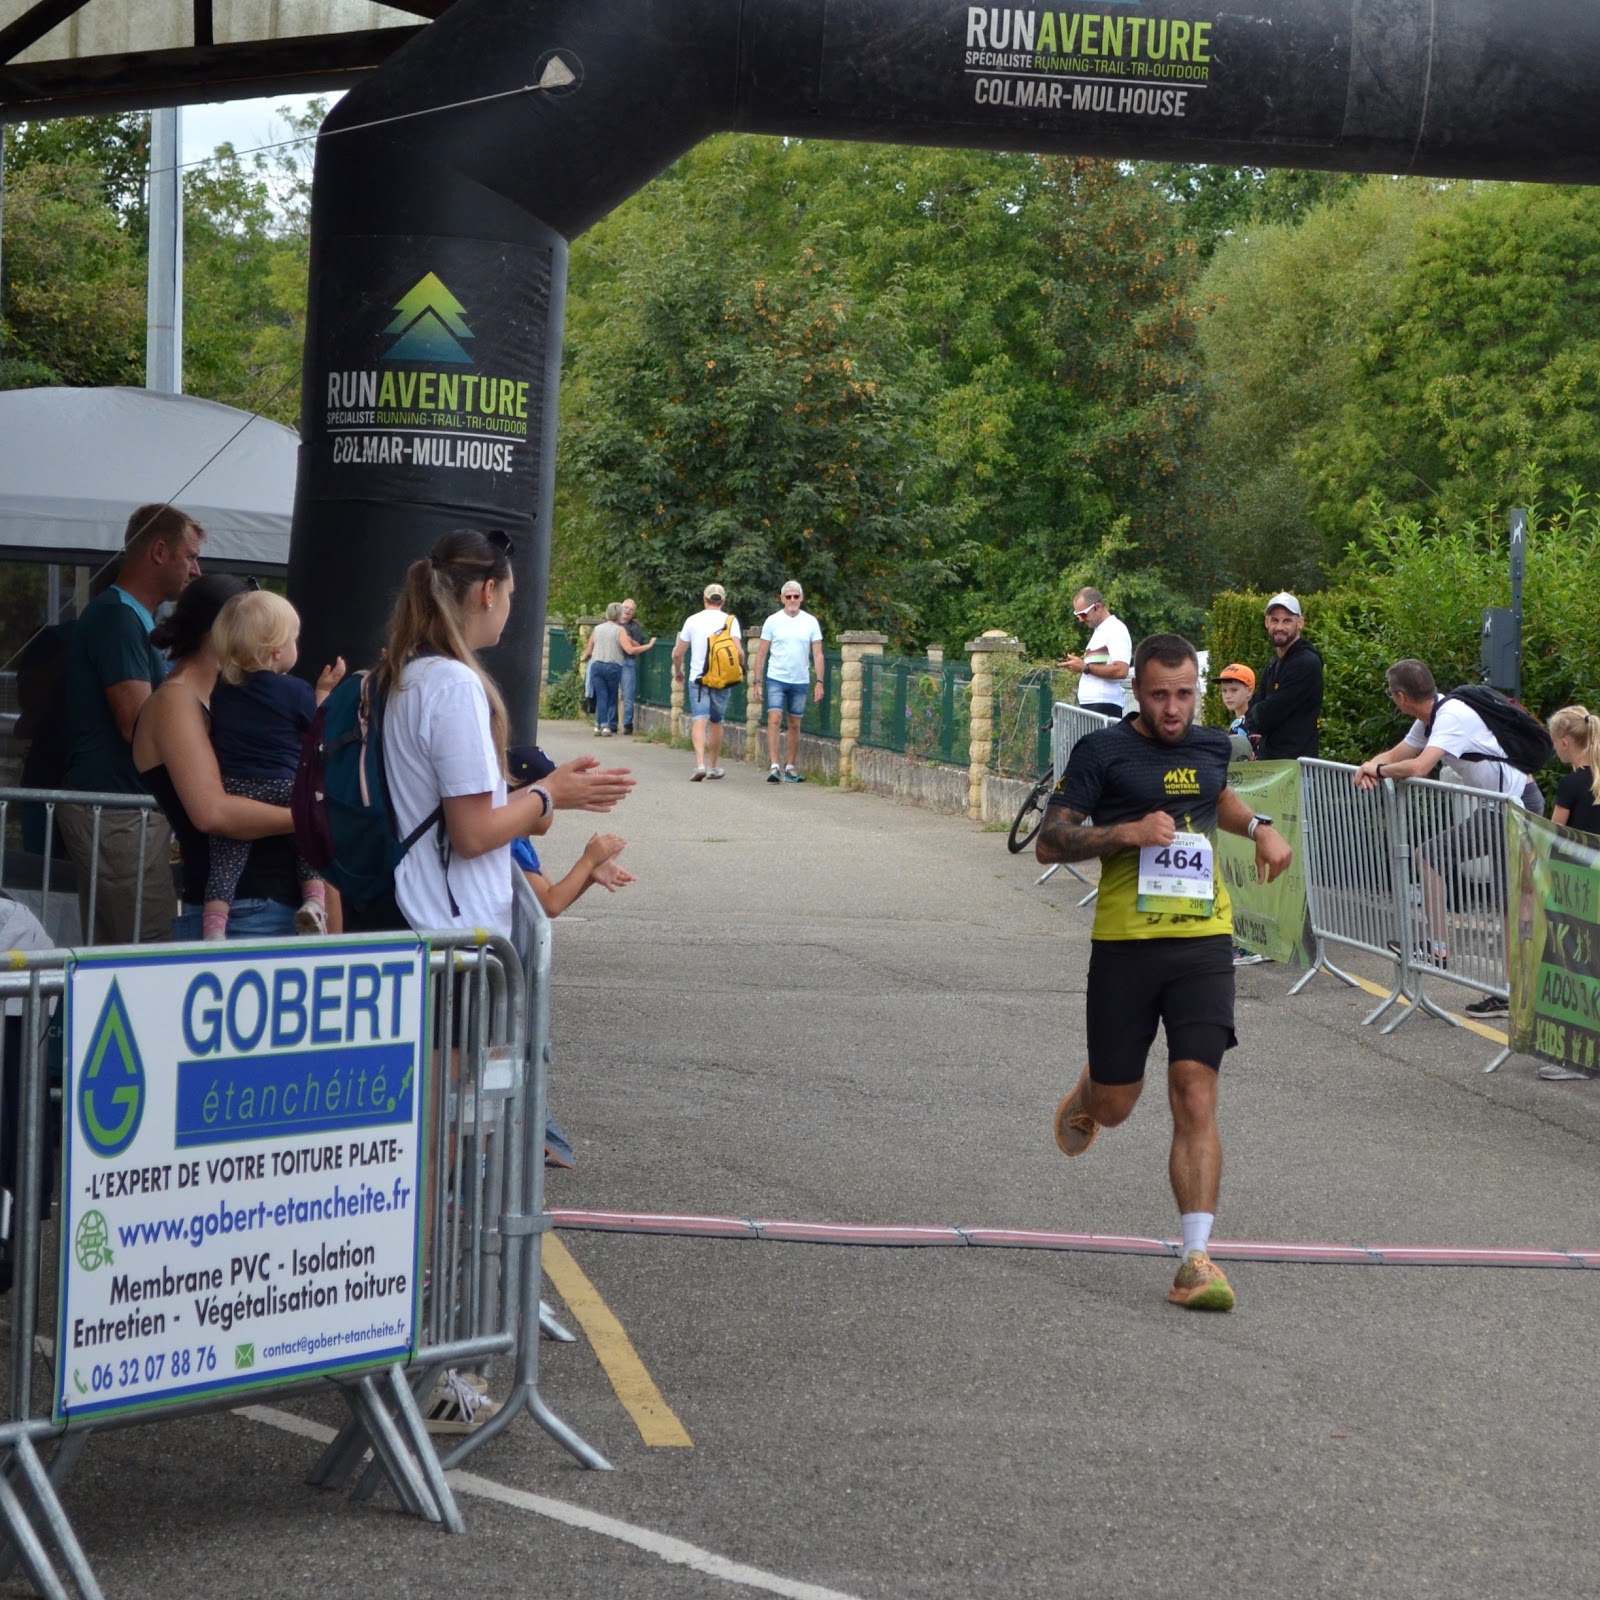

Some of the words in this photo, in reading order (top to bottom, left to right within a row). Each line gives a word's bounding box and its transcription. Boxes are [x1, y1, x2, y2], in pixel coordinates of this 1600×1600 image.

[966, 6, 1213, 63] RUNAVENTURE
[965, 47, 1033, 69] SPÉCIALISTE
[1034, 55, 1209, 80] RUNNING-TRAIL-TRI-OUTDOOR
[975, 78, 1188, 118] COLMAR-MULHOUSE
[327, 370, 529, 419] RUNAVENTURE
[326, 408, 375, 425] SPÉCIALISTE
[376, 411, 528, 436] RUNNING-TRAIL-TRI-OUTDOOR
[332, 436, 514, 473] COLMAR-MULHOUSE
[1163, 767, 1197, 784] MXT
[1154, 848, 1203, 871] 464
[181, 960, 415, 1058] GOBERT
[1541, 970, 1579, 1012] ADOS
[1535, 1018, 1566, 1061] KIDS
[202, 1065, 388, 1124] étanchéité
[177, 1161, 200, 1187] DE
[206, 1153, 265, 1185] VOTRE
[271, 1144, 343, 1177] TOITURE
[117, 1177, 412, 1248] www.gobert-etancheite.fr
[108, 1264, 223, 1306] Membrane
[230, 1252, 271, 1286] PVC
[292, 1240, 375, 1276] Isolation
[73, 1307, 166, 1349] Entretien
[195, 1277, 338, 1333] Végétalisation
[345, 1270, 407, 1304] toiture
[262, 1318, 406, 1360] contact@gobert-etancheite.fr
[91, 1364, 113, 1392] 06
[118, 1358, 139, 1387] 32
[144, 1353, 165, 1383] 07
[171, 1349, 191, 1378] 88
[196, 1345, 217, 1373] 76
